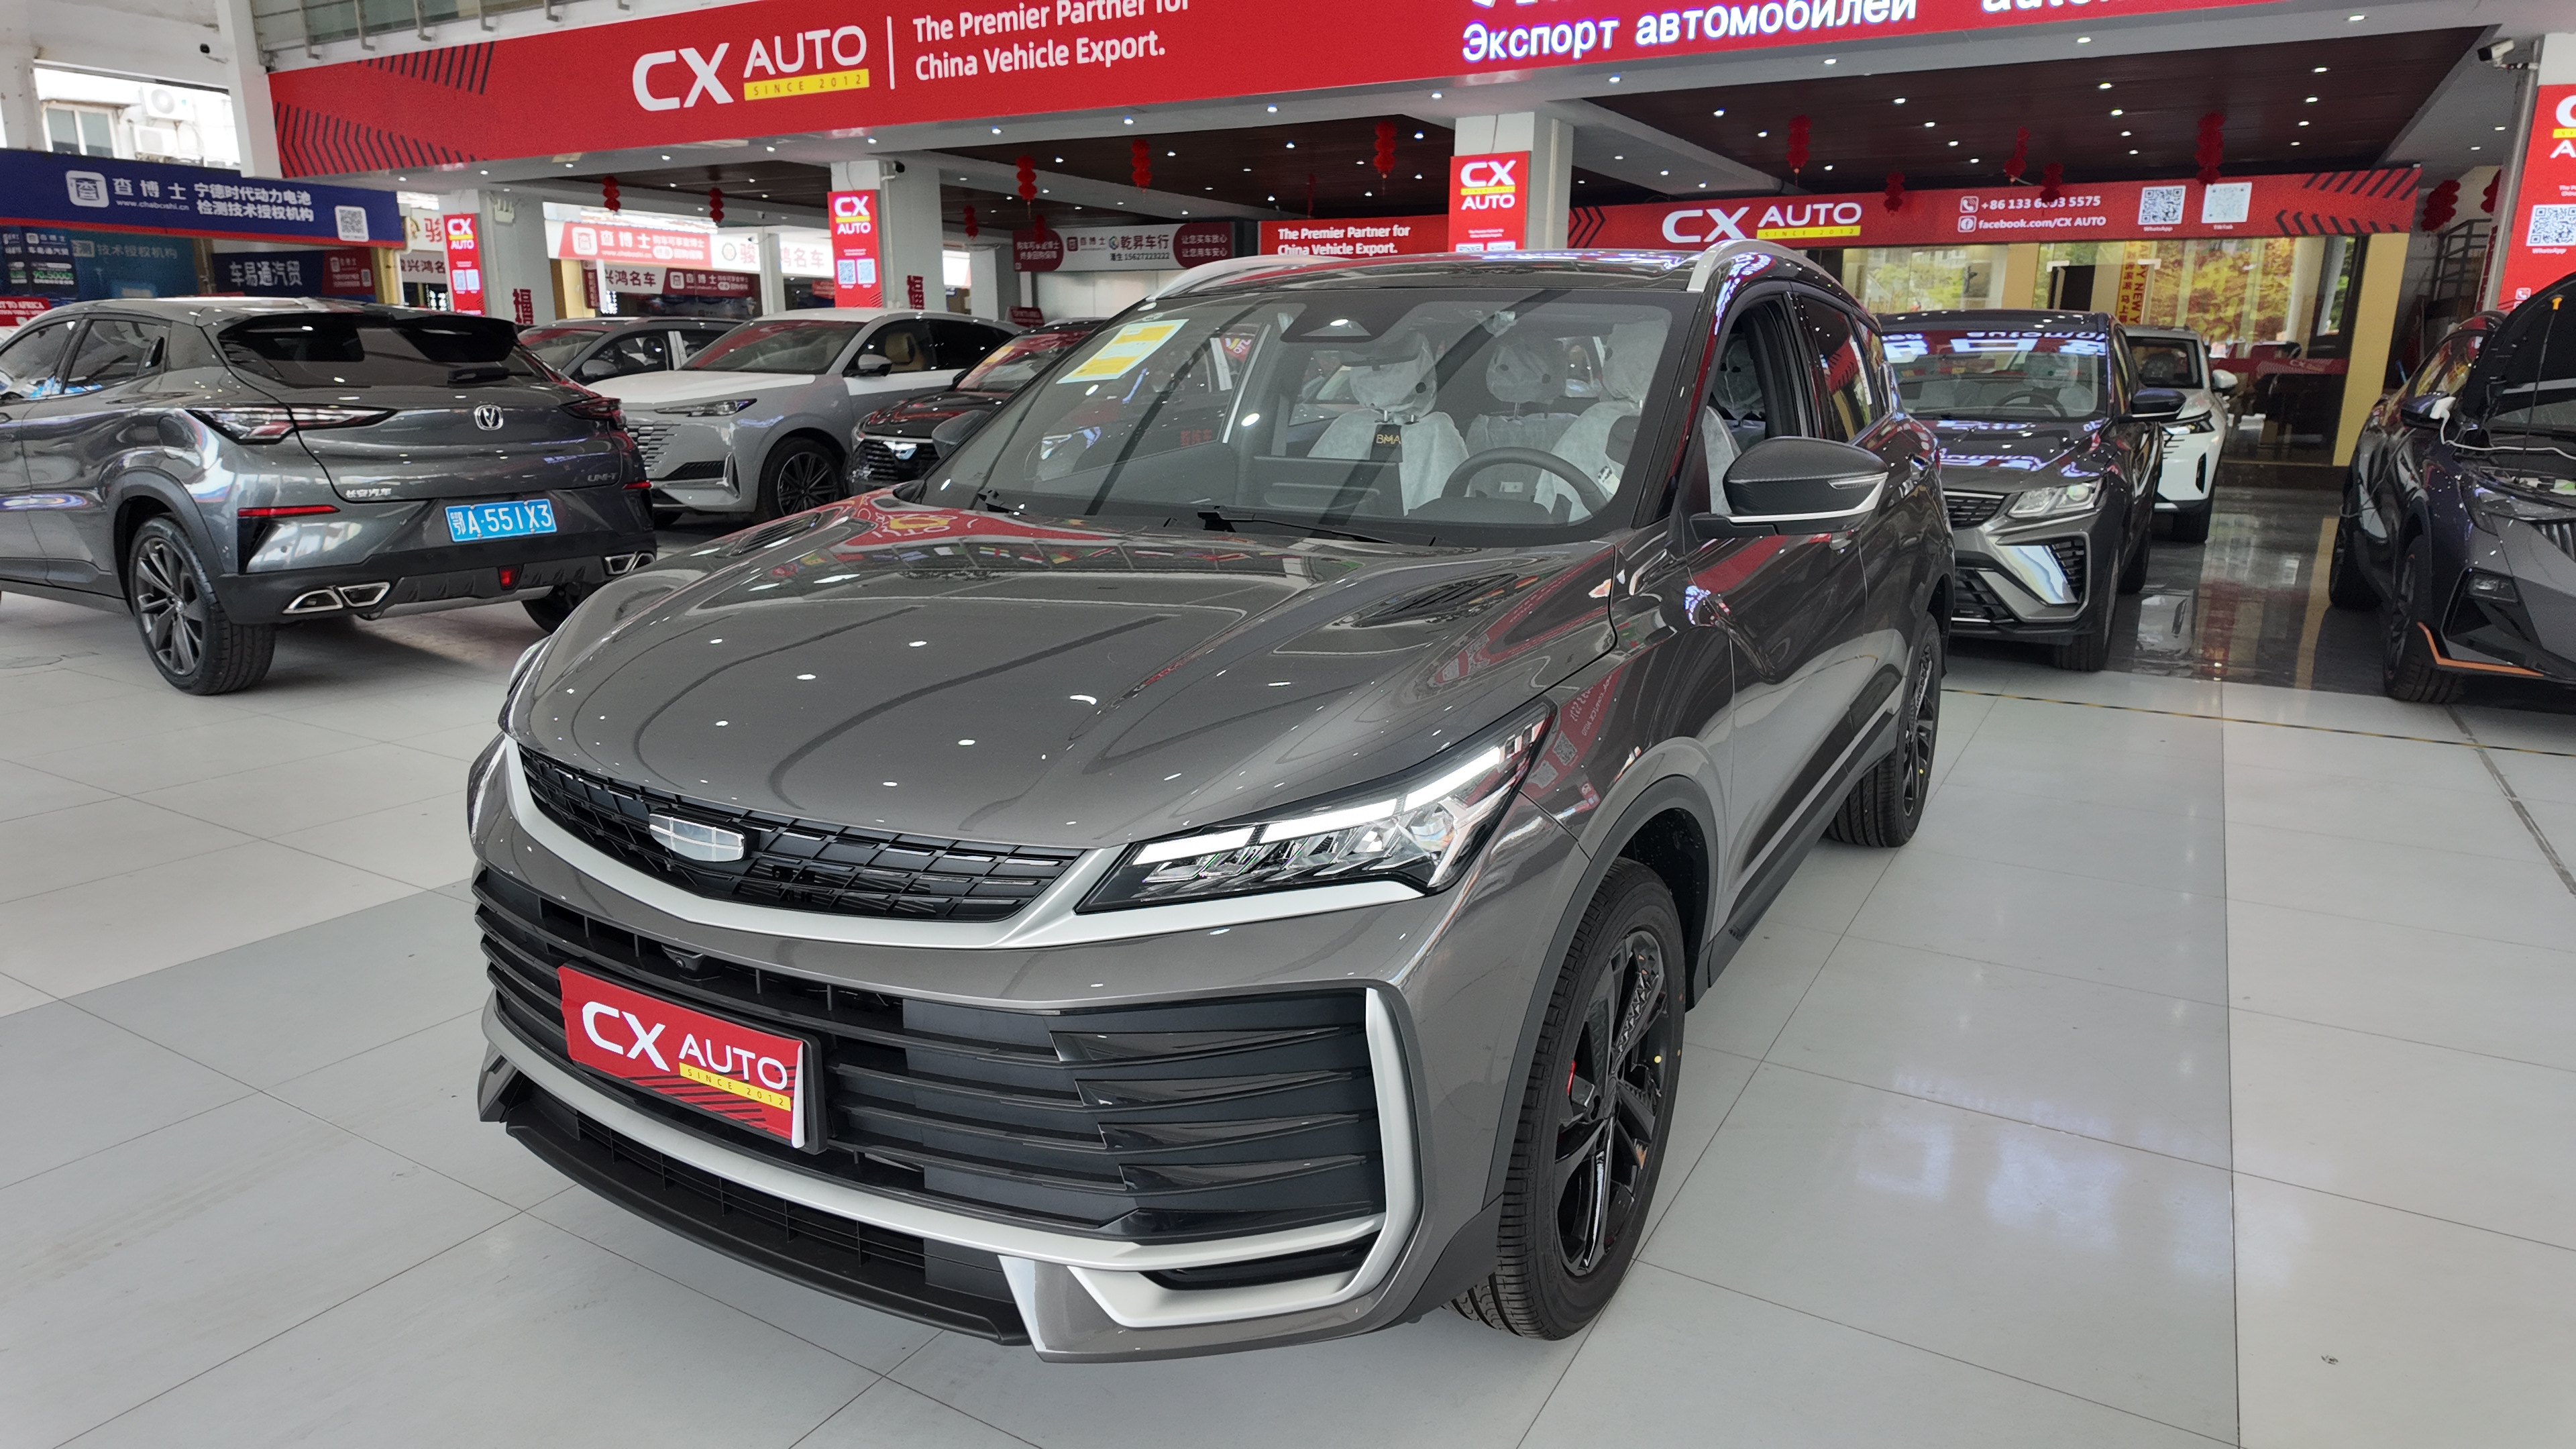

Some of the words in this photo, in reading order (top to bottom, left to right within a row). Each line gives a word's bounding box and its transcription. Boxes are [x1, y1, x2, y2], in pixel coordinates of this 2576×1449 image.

[913, 15, 953, 43] The
[959, 3, 1051, 38] Premier
[1057, 0, 1144, 25] Partner
[1462, 18, 1619, 61] Экспорт
[915, 51, 978, 80] China
[983, 39, 1069, 73] Vehicle
[1076, 30, 1165, 68] Export.
[633, 43, 734, 111] CX
[743, 25, 867, 78] AUTO
[753, 81, 804, 96] SINCE
[819, 74, 861, 89] 2012
[1460, 160, 1516, 187] CX
[112, 178, 186, 200] 查博士
[194, 182, 312, 205] 宁德时代动力电池
[197, 200, 314, 222] 检测技术授权机构
[835, 196, 869, 217] CX
[1460, 194, 1515, 210] AUTO
[1981, 199, 2005, 210] +86
[2008, 199, 2031, 209] 133
[2069, 196, 2101, 207] 5575
[447, 218, 472, 235] CX
[837, 222, 871, 234] AUTO
[1278, 228, 1299, 239] The
[1301, 227, 1344, 239] Premier
[1347, 225, 1391, 237] Partner
[1393, 224, 1411, 236] for
[1662, 207, 1750, 243] CX
[1758, 203, 1862, 227] AUTO
[1979, 217, 2072, 229] facebook.com/CX
[2074, 216, 2106, 227] AUTO
[451, 239, 474, 250] AUTO
[1278, 244, 1309, 256] China
[1311, 243, 1353, 255] Vehicle
[1356, 242, 1397, 256] Export.
[229, 260, 303, 286] 车易通汽贸
[513, 288, 533, 324] 福
[2132, 282, 2145, 311] NEW
[582, 1002, 671, 1071] CX
[678, 1033, 788, 1090] AUTO
[688, 1069, 733, 1090] SINCE
[747, 1087, 784, 1106] 2012
